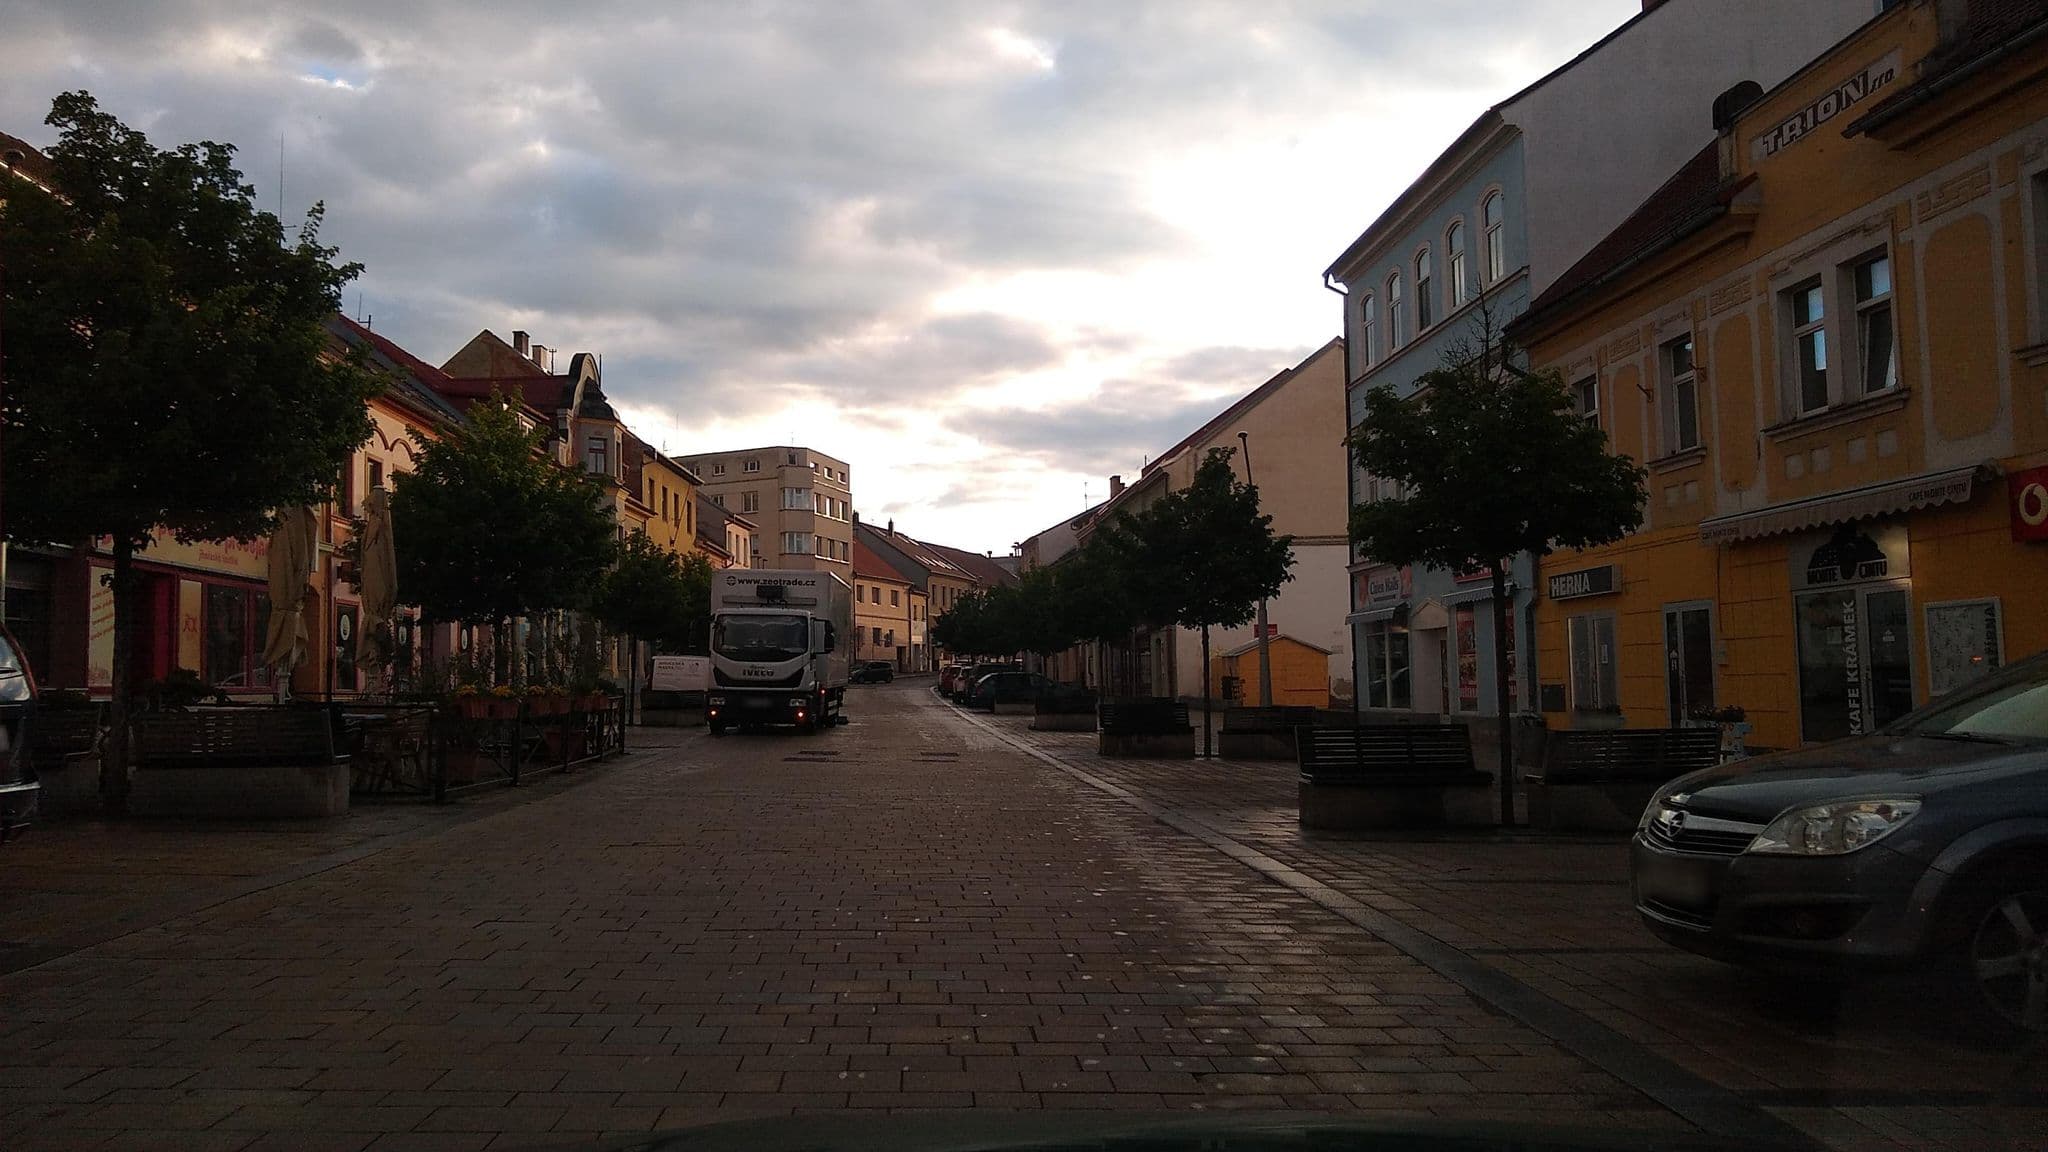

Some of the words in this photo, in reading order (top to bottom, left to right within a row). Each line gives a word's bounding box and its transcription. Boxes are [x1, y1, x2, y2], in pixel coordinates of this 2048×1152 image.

[1763, 70, 1868, 156] TRION
[1551, 573, 1591, 597] HERNA
[1841, 599, 1860, 683] KRÁMEK
[743, 669, 775, 677] IVECO
[1847, 687, 1863, 736] KAFE
